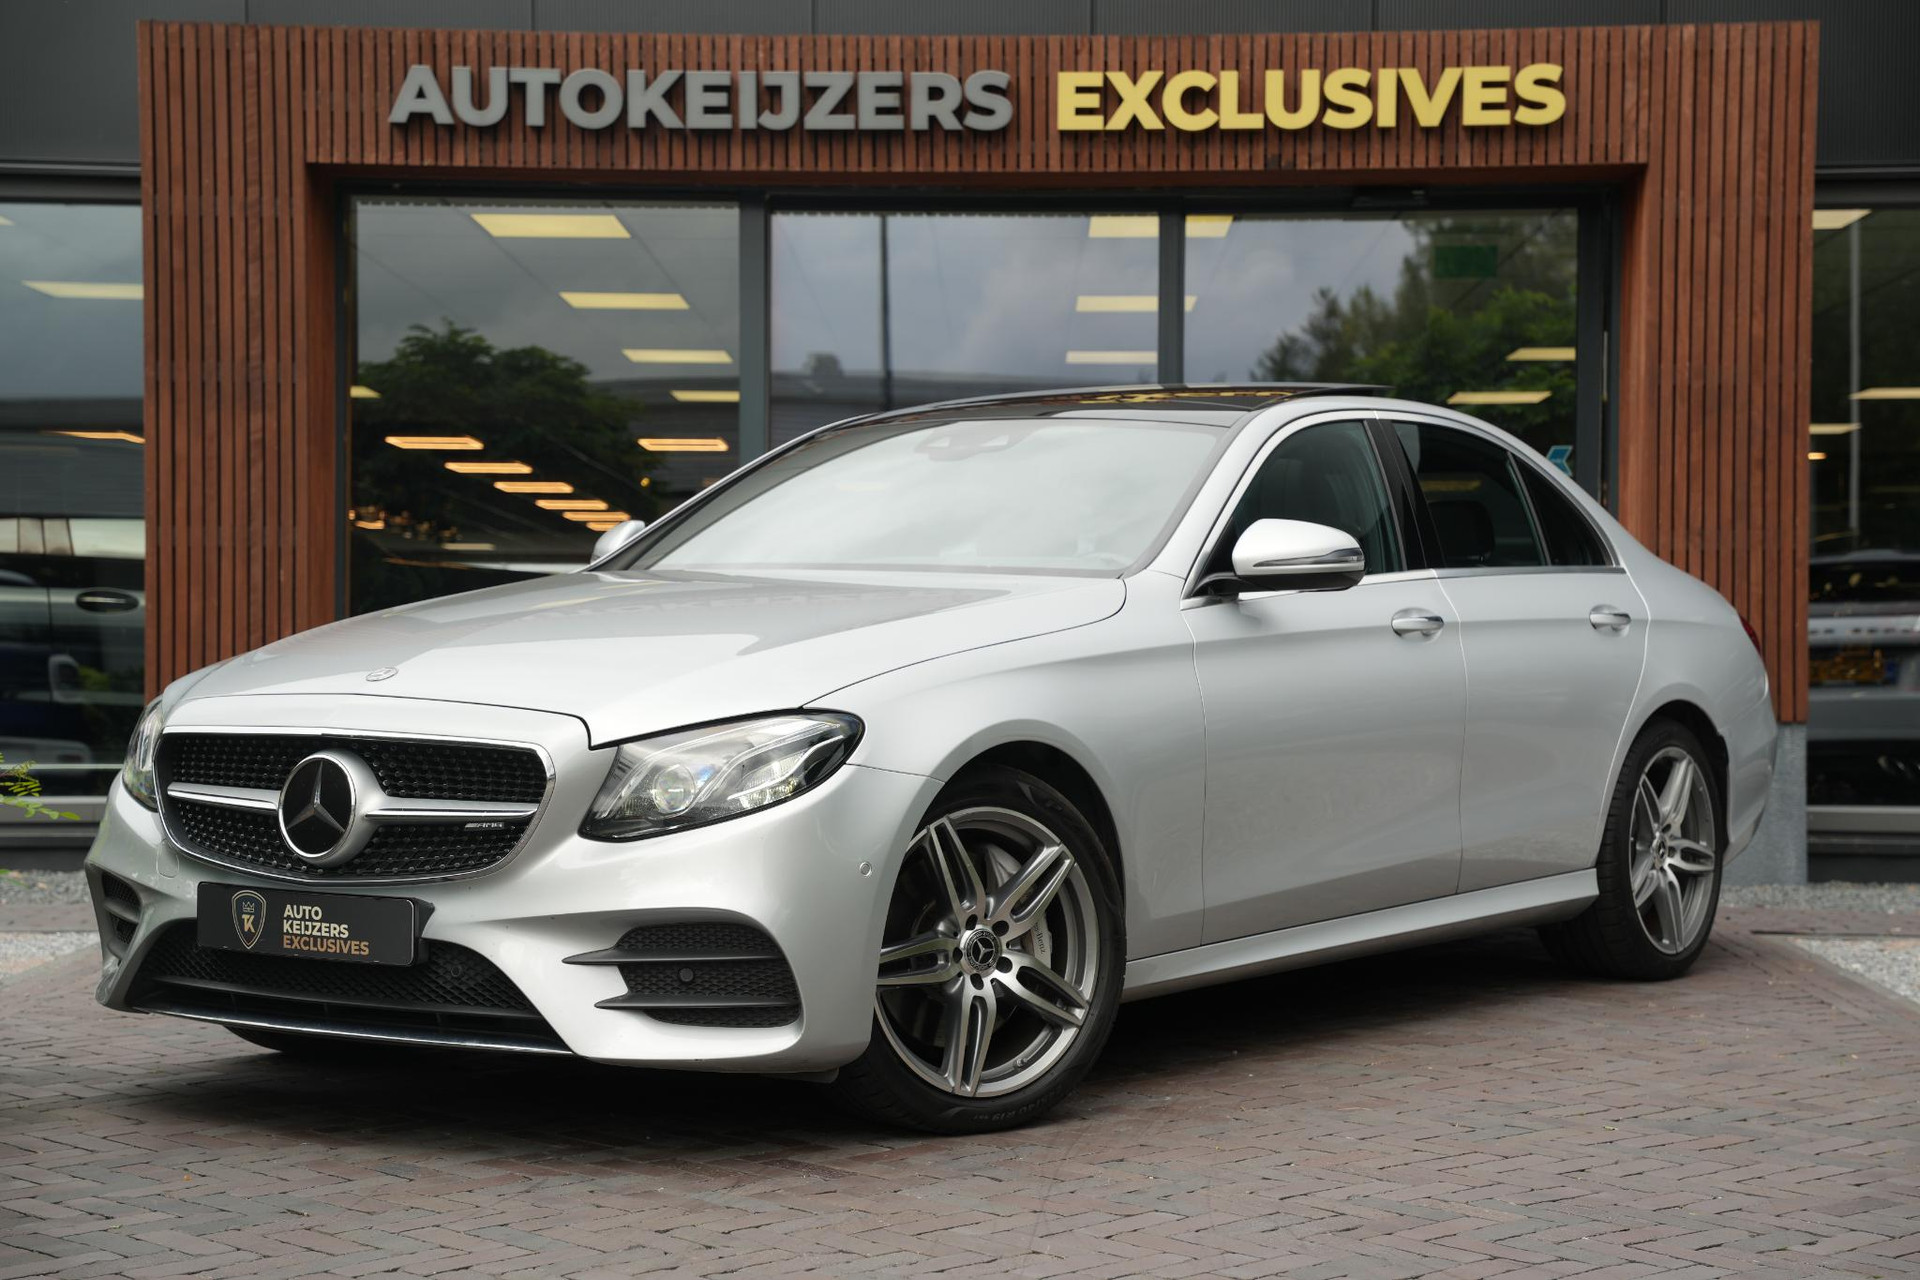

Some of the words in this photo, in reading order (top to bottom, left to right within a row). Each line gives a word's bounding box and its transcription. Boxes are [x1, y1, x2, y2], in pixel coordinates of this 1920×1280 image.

[388, 64, 1014, 131] AUTOKEIJZERS
[1056, 62, 1567, 132] EXCLUSIVES
[283, 904, 323, 920] AUTO
[283, 919, 349, 938] KEIJZERS
[283, 934, 370, 955] EXCLUSIVES
